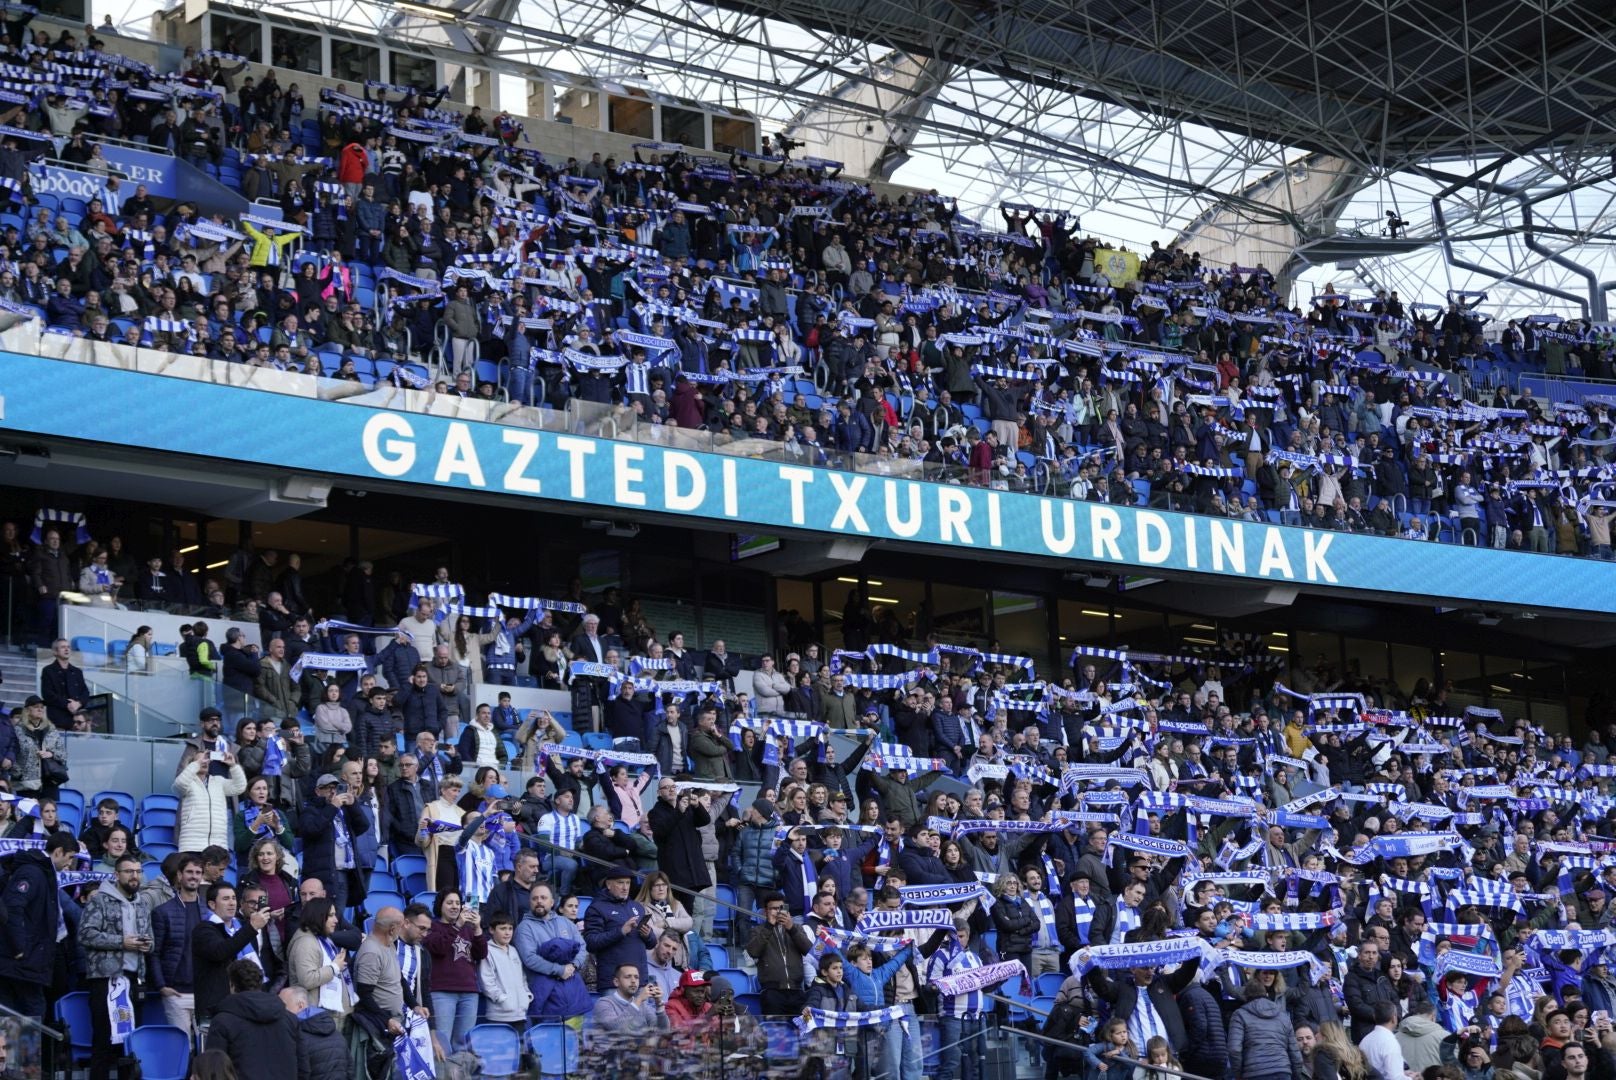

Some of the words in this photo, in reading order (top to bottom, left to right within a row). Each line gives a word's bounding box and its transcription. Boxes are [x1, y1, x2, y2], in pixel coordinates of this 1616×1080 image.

[643, 336, 675, 348] SOCIEDAD
[362, 410, 738, 518] GAZTEDI
[780, 466, 1002, 548] TXURI
[1041, 499, 1339, 584] URDINAK
[1176, 721, 1208, 732] SOCIEDAD
[961, 820, 996, 830] REAL
[1112, 833, 1138, 844] REAL
[1138, 836, 1185, 852] SOCIEDAD
[1181, 871, 1242, 887] SOCIEDAD
[950, 884, 977, 895] REAL
[1546, 933, 1566, 945] Beti
[1577, 933, 1606, 945] Zuekin
[1100, 939, 1190, 956] LEIALTASUNA
